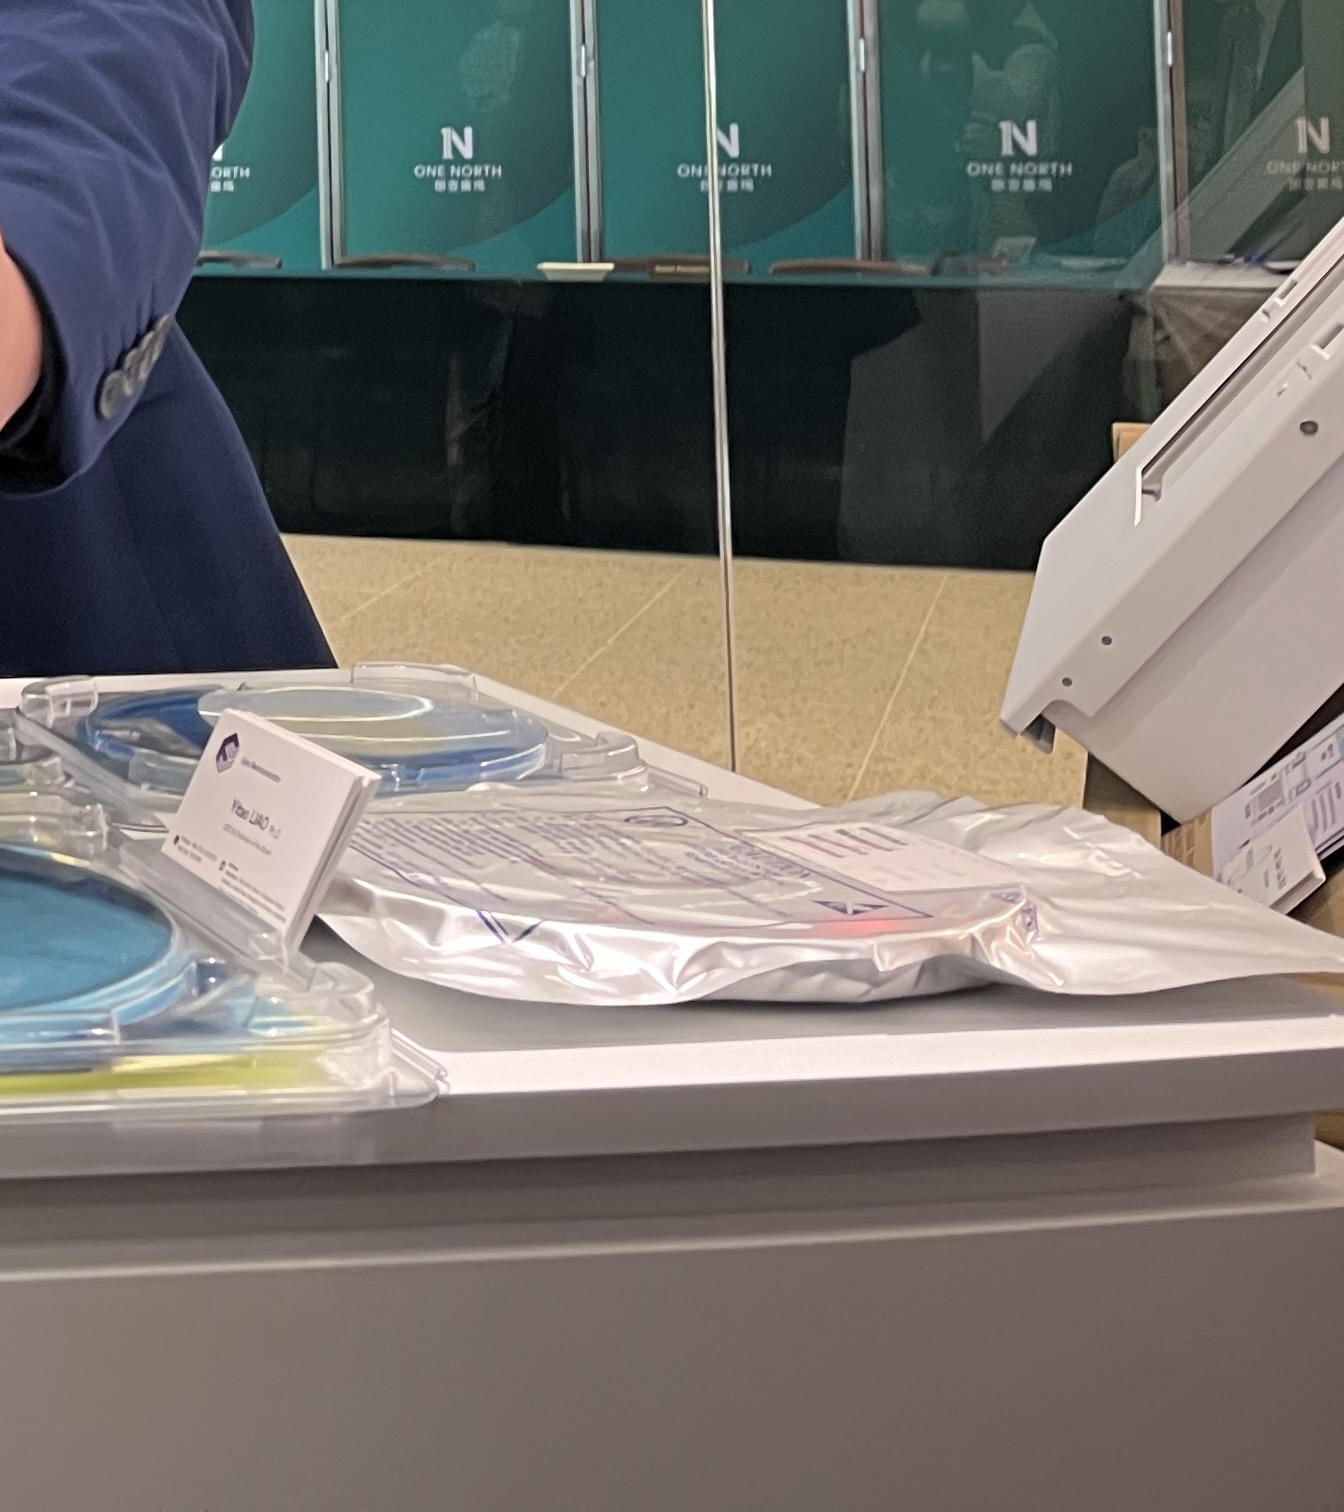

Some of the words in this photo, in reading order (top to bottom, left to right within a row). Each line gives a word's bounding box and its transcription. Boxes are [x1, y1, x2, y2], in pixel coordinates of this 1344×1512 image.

[414, 165, 444, 178] ONE
[450, 165, 502, 178] NORTH
[677, 164, 709, 178] ON
[967, 163, 1003, 176] ONE
[1010, 162, 1072, 177] NORTH
[1306, 159, 1344, 172] NOR
[212, 167, 250, 179] ORTH
